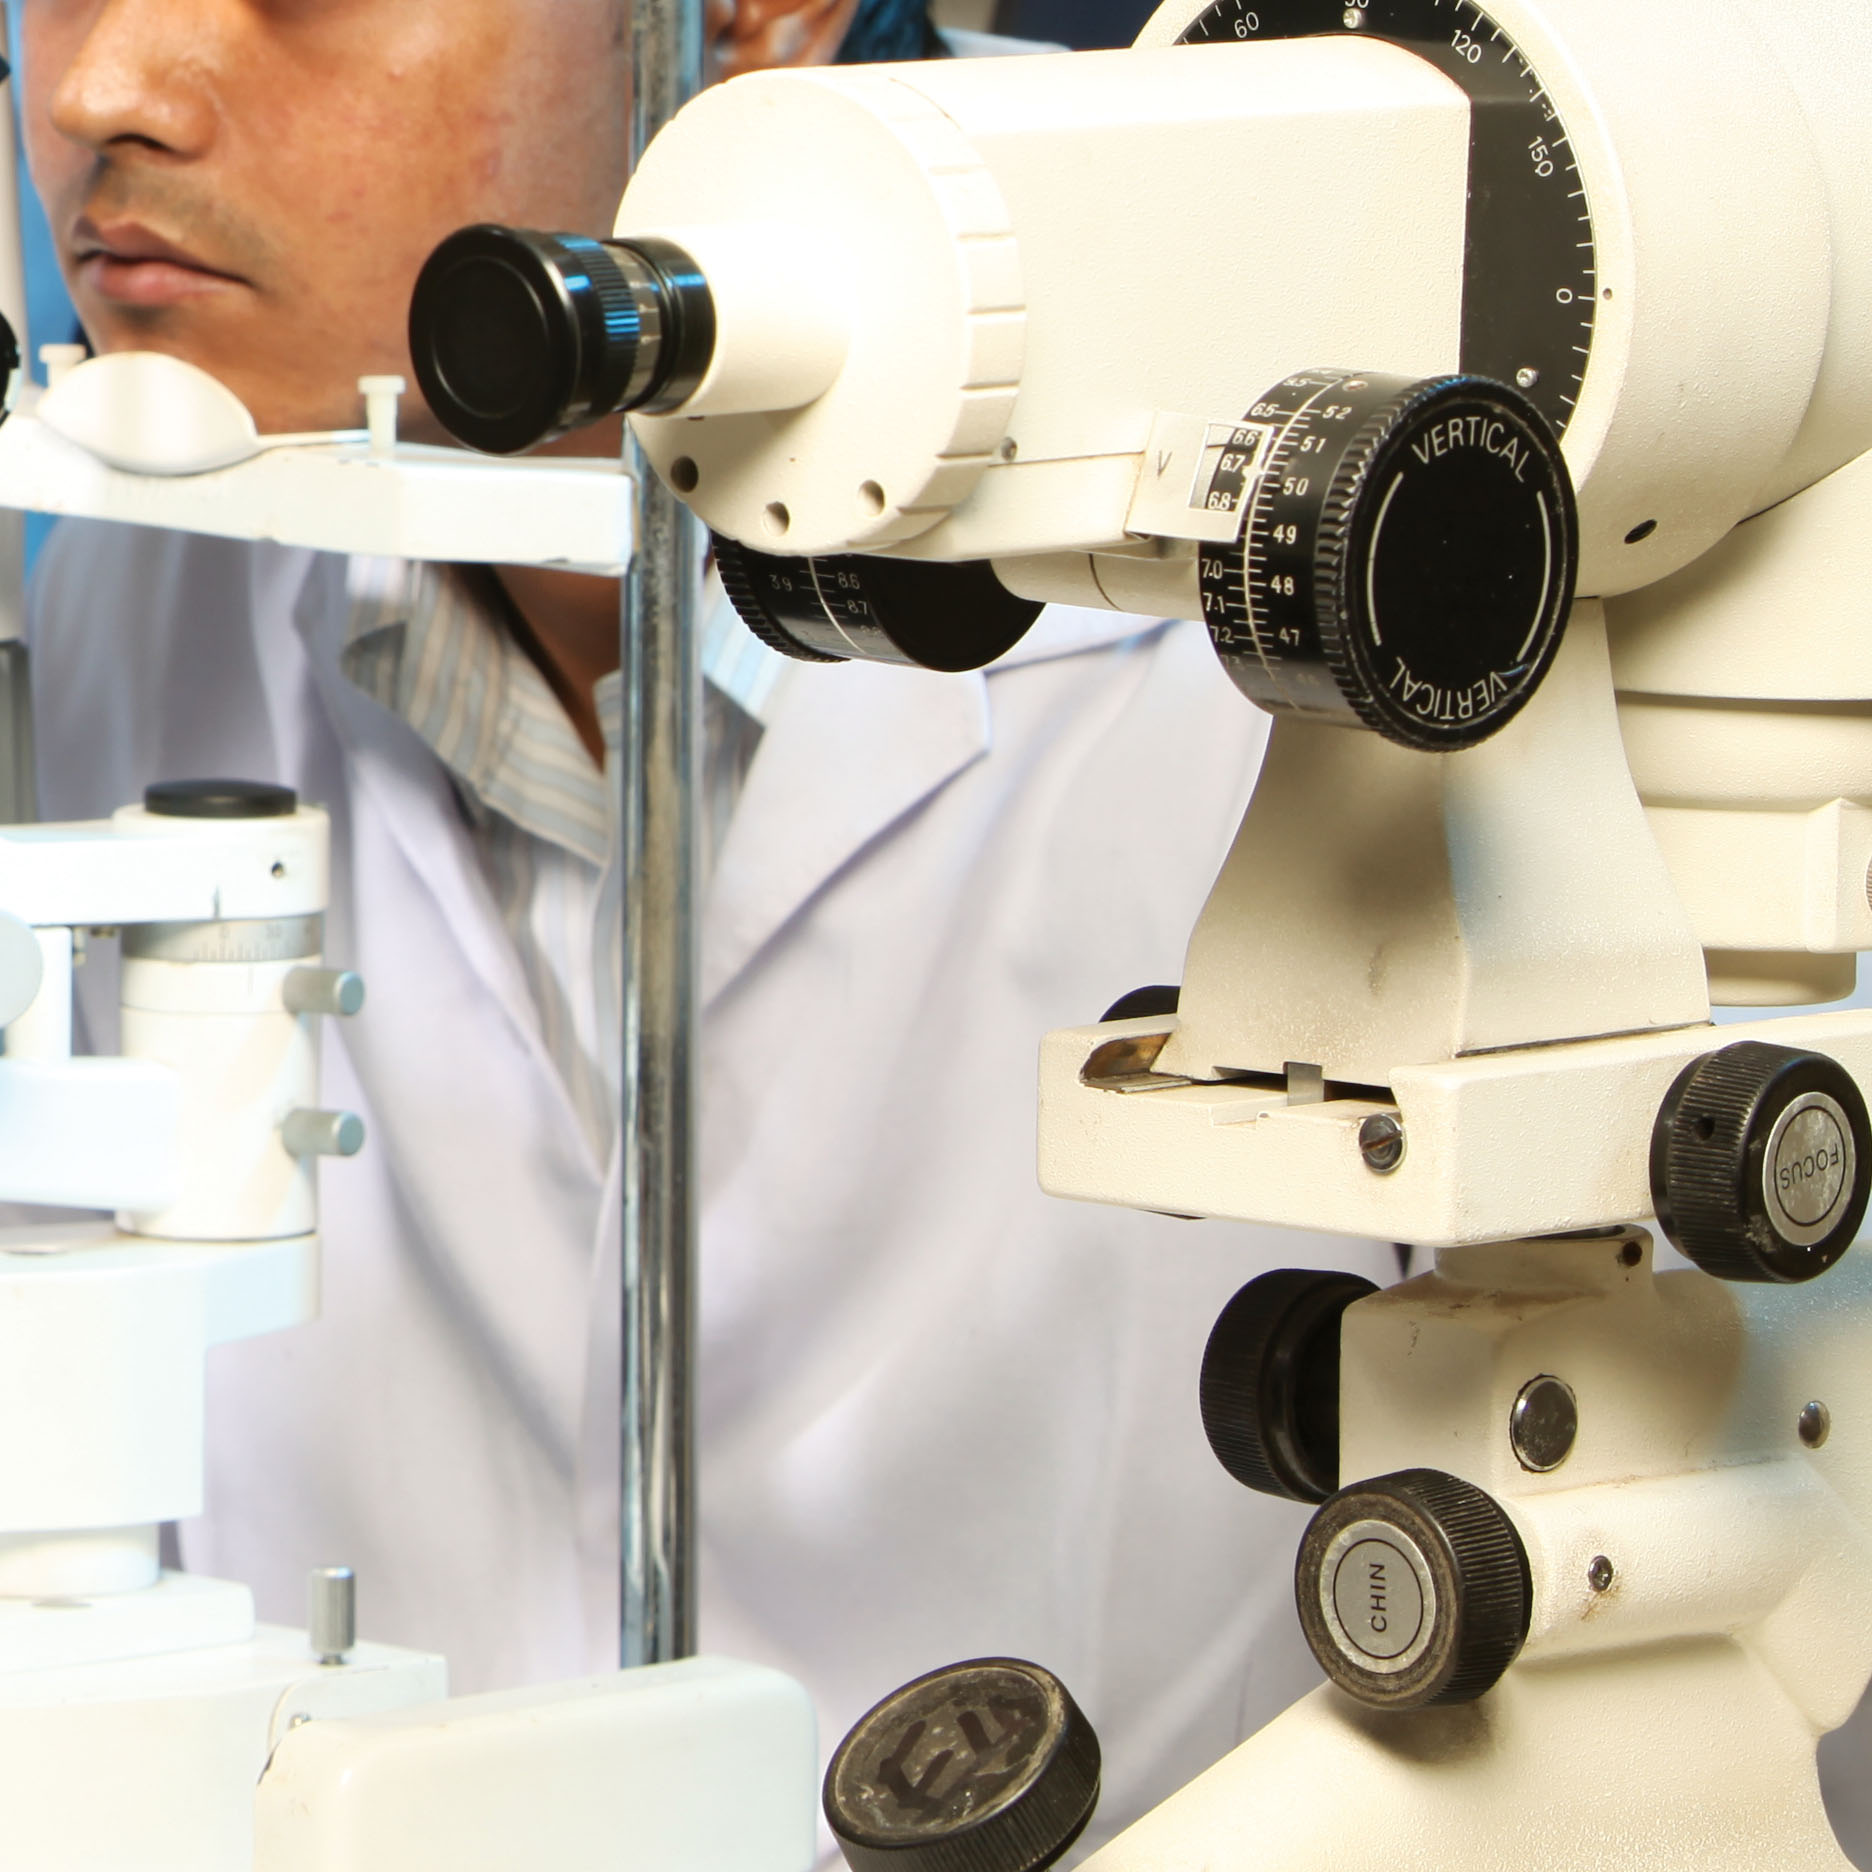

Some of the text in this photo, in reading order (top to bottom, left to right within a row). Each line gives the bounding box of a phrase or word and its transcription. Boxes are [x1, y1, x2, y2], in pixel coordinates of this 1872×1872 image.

[1233, 11, 1260, 39] 60
[1449, 29, 1482, 64] 120
[1527, 135, 1554, 177] 150
[1555, 287, 1573, 304] 0
[1322, 405, 1353, 420] 52
[1299, 436, 1327, 453] 51
[1411, 416, 1531, 483] VERTICAL
[1282, 478, 1309, 496] 50
[1272, 525, 1297, 544] 49
[1201, 558, 1223, 579] 7.0
[1270, 575, 1295, 596] 48
[1202, 592, 1225, 614] 7.1
[1278, 628, 1300, 646] 47
[1389, 656, 1508, 720] VERTICAL
[1779, 1143, 1839, 1190] FOCUS
[1369, 1563, 1387, 1633] CHIN
